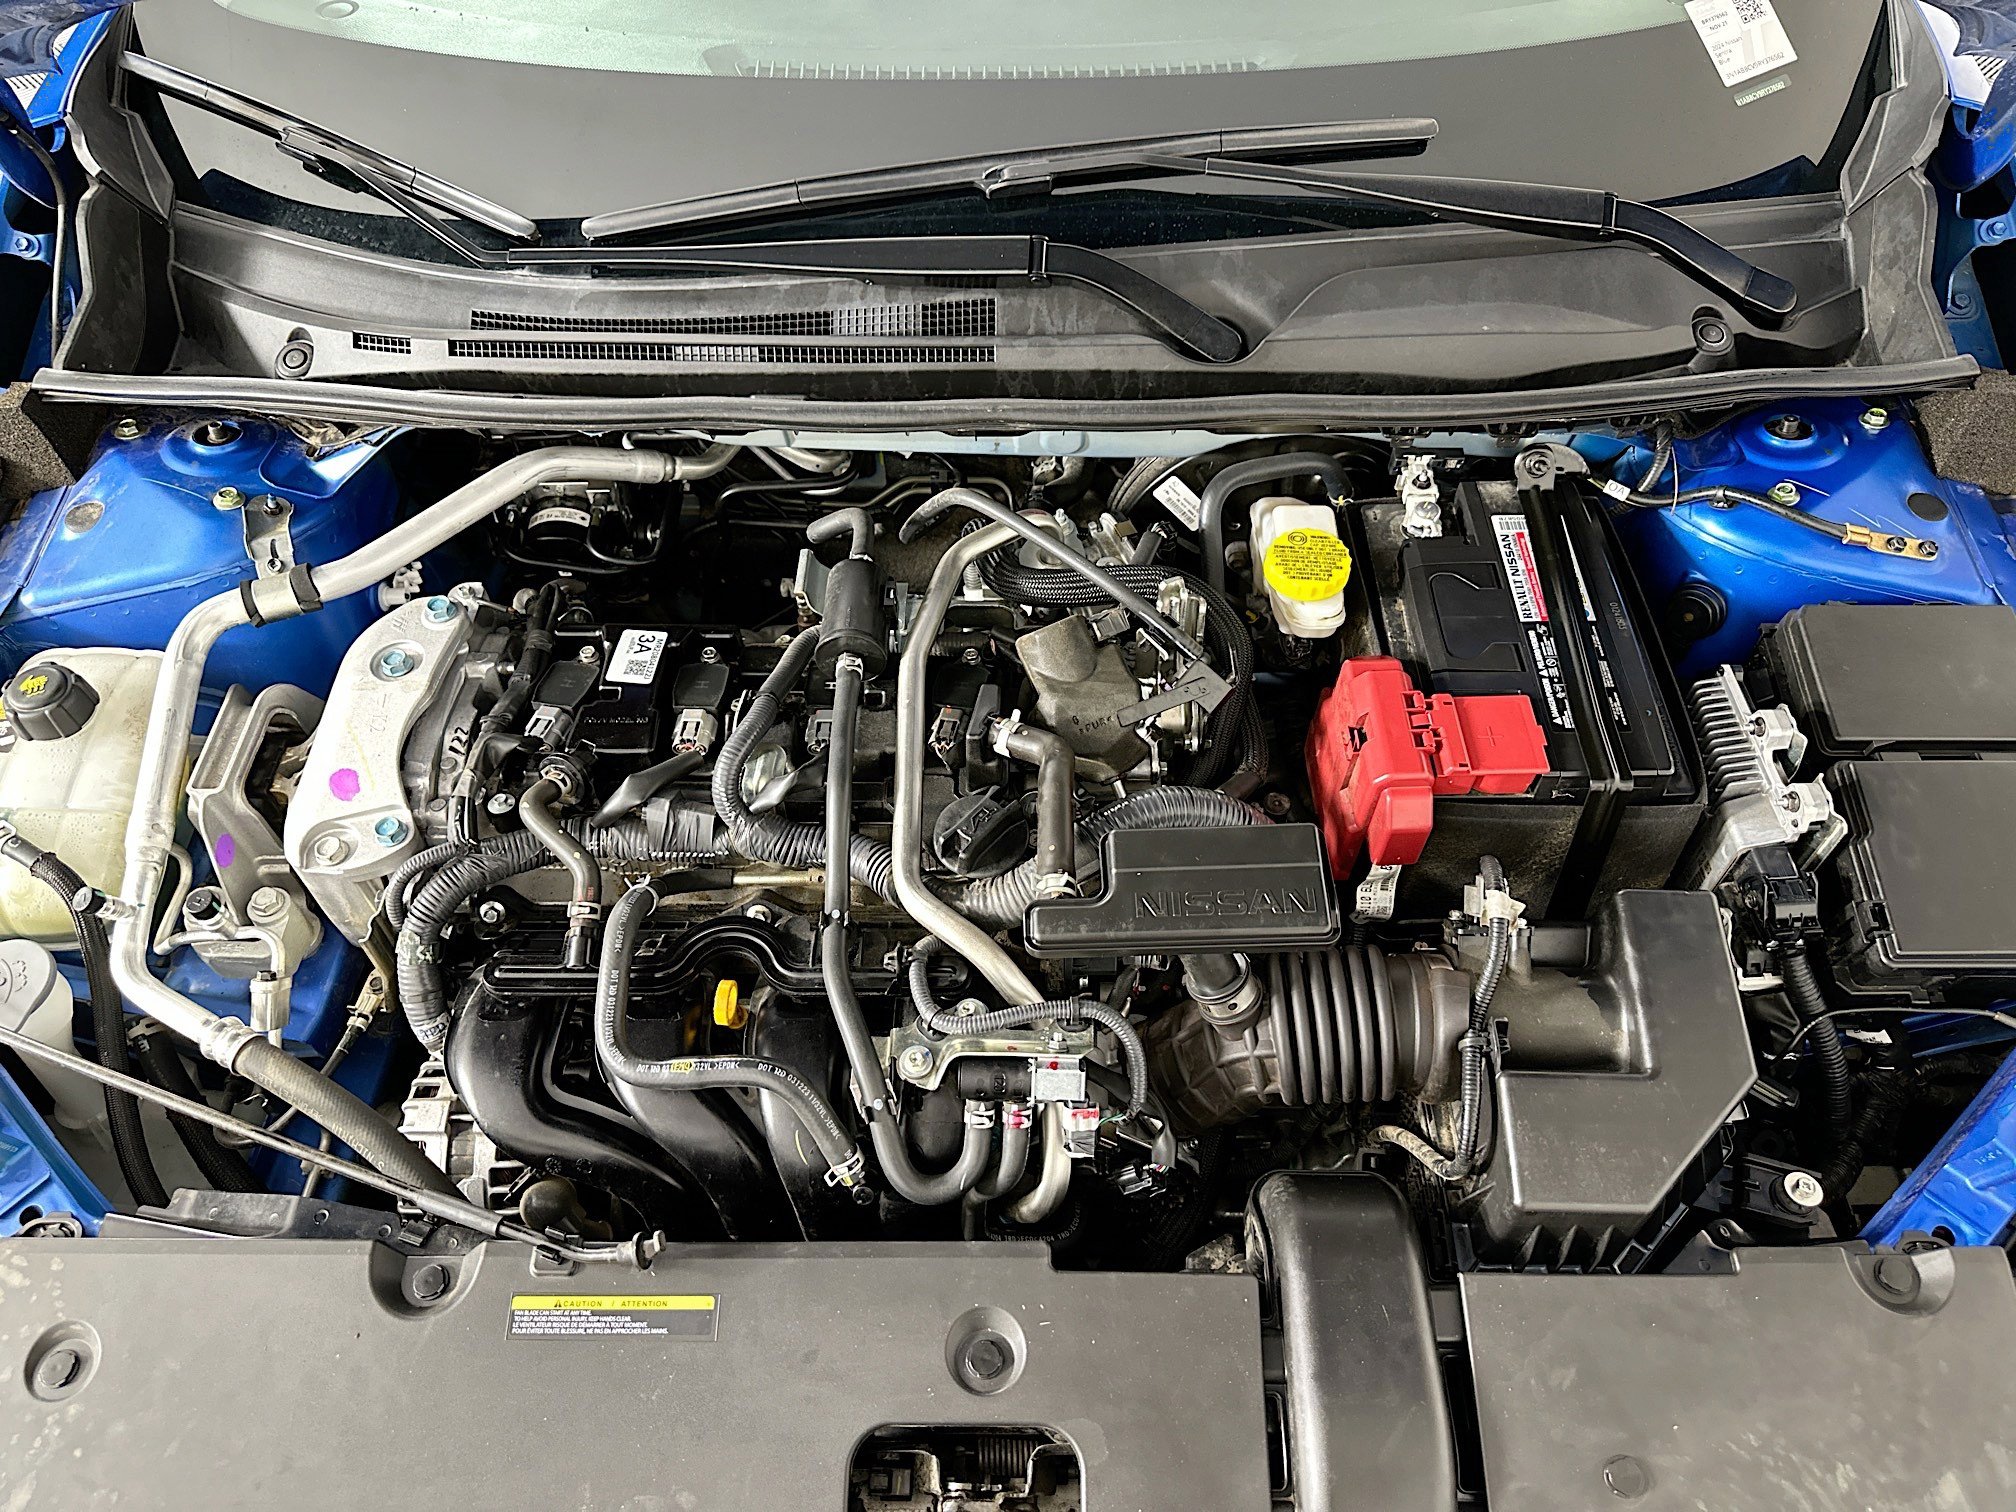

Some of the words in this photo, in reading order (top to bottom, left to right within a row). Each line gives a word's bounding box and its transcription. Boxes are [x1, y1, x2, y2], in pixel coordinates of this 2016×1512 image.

[1709, 23, 1722, 31] NOV
[1711, 42, 1725, 52] 2024
[1500, 534, 1520, 577] NISSAN
[1513, 579, 1533, 619] RENAULT
[633, 634, 656, 655] 3A
[449, 726, 470, 755] 122
[1134, 887, 1318, 918] NISSAN
[611, 969, 620, 983] DOT
[636, 1064, 648, 1073] DOT
[758, 1062, 772, 1073] DOT
[787, 1074, 811, 1096] 031223
